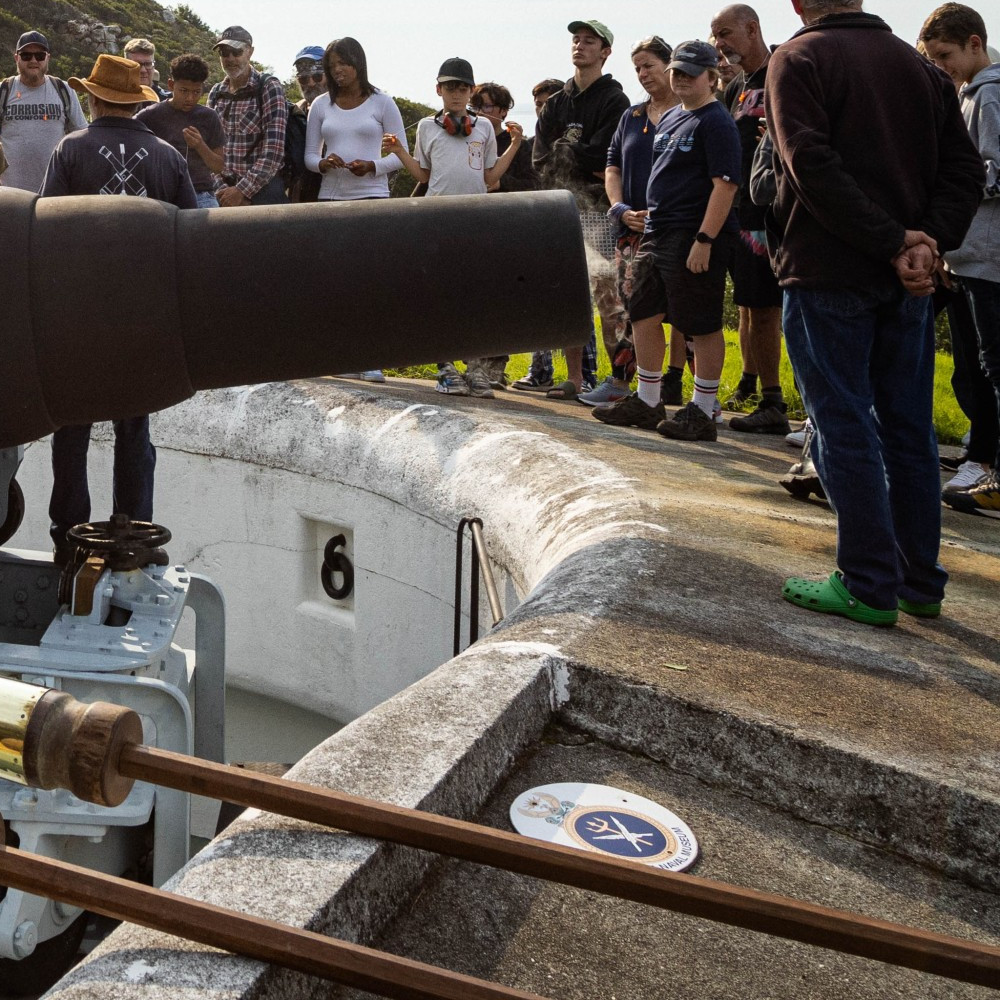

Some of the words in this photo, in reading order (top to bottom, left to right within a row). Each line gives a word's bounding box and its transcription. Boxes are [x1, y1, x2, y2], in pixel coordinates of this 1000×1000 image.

[321, 534, 354, 600] 6
[671, 827, 692, 856] MUSEUM
[658, 857, 688, 869] NAVAL
